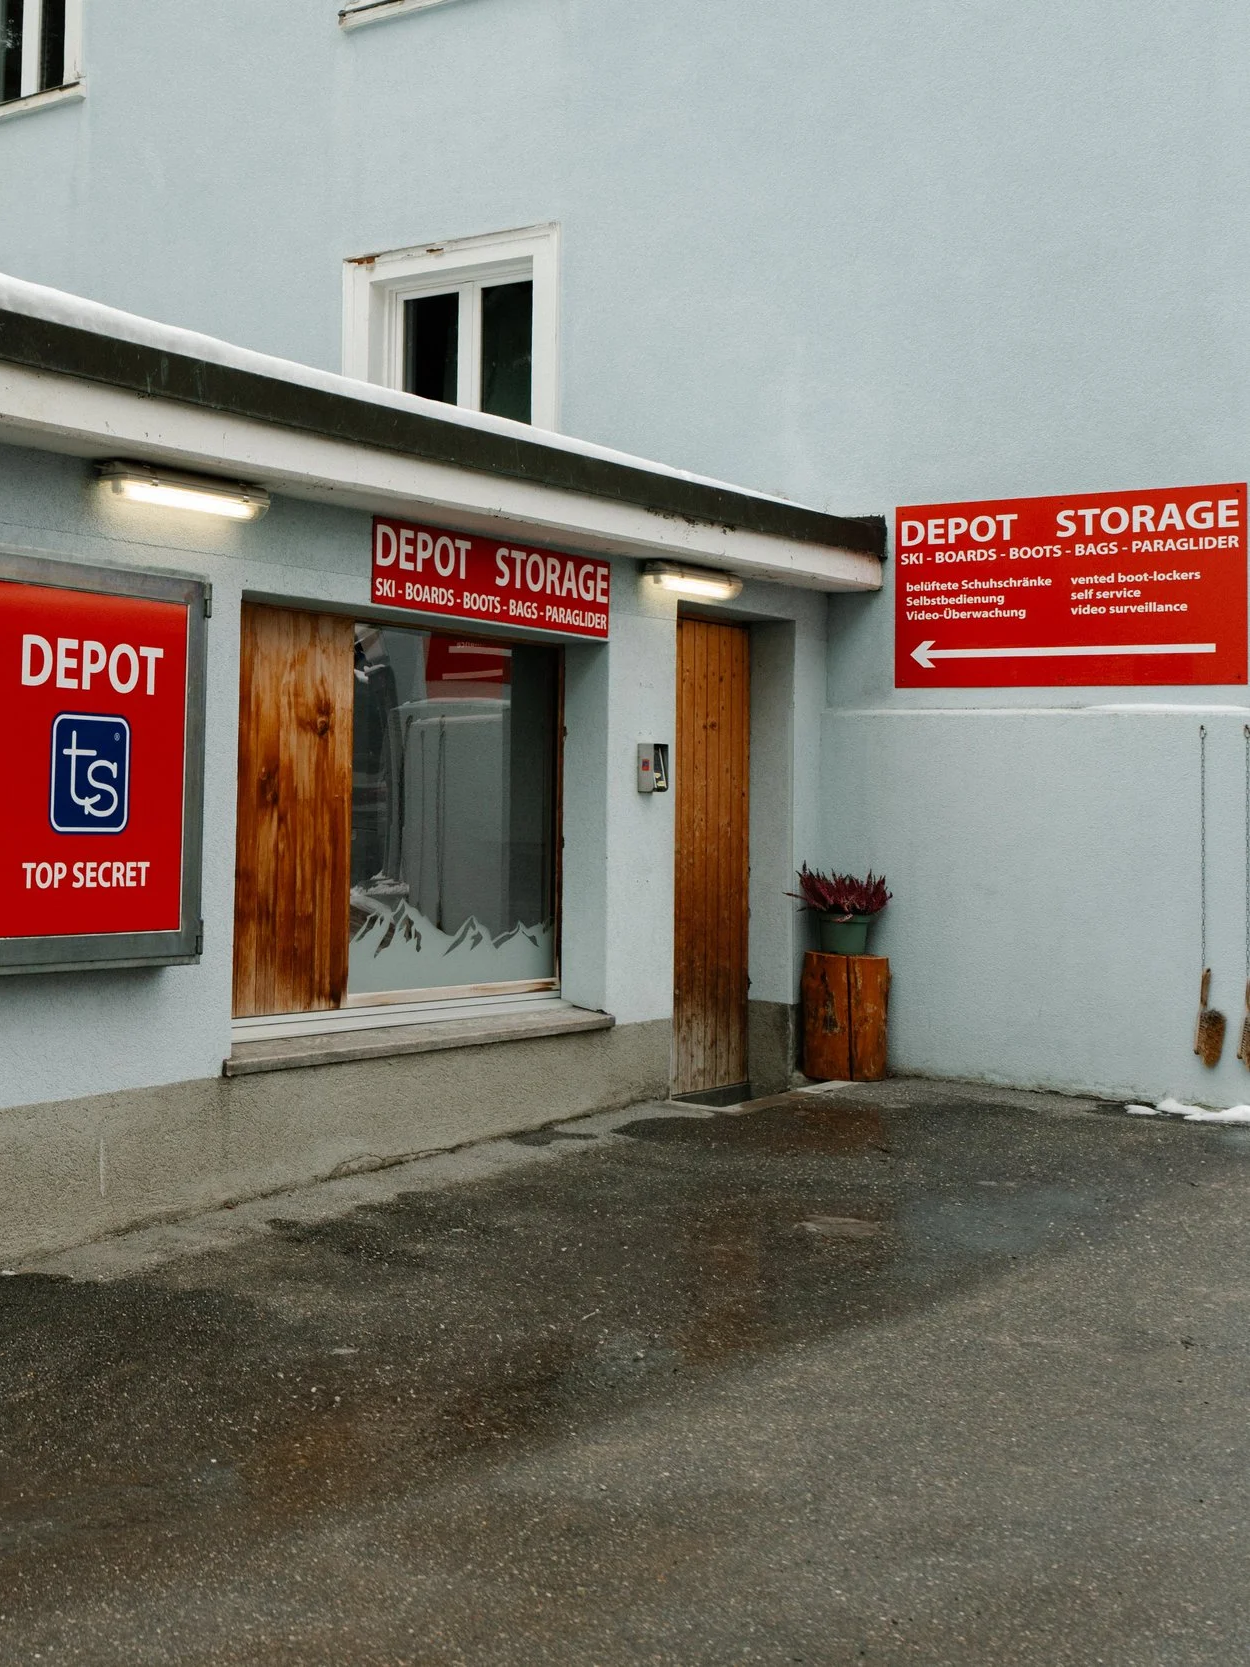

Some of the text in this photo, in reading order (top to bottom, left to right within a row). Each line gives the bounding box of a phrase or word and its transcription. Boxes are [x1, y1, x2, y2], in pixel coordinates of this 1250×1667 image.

[902, 499, 1239, 546] DEPOT STORAGE
[901, 553, 923, 565] SKI
[936, 549, 996, 563] BOARDS
[1010, 545, 1062, 559] BOOTS
[1075, 542, 1118, 556] BAGS
[1132, 535, 1239, 552] PARAGLIDER
[376, 524, 608, 603] DEPOT STORAGE
[907, 577, 1052, 591] belüftete Schuhschränke
[1071, 570, 1201, 584] vented boot-lockers
[376, 578, 395, 597] SKI
[406, 582, 454, 606] BOARDS
[463, 592, 500, 613] BOOTS
[509, 599, 538, 619] BAGS
[545, 605, 606, 630] PARAGLIDER
[907, 594, 1004, 606] Selbstbedienung
[1071, 588, 1141, 600] self service
[906, 608, 1026, 620] Video-Überwachung
[1071, 602, 1187, 615] video surveillance
[22, 634, 163, 695] DEPOT
[22, 862, 150, 888] TOP SECRET
